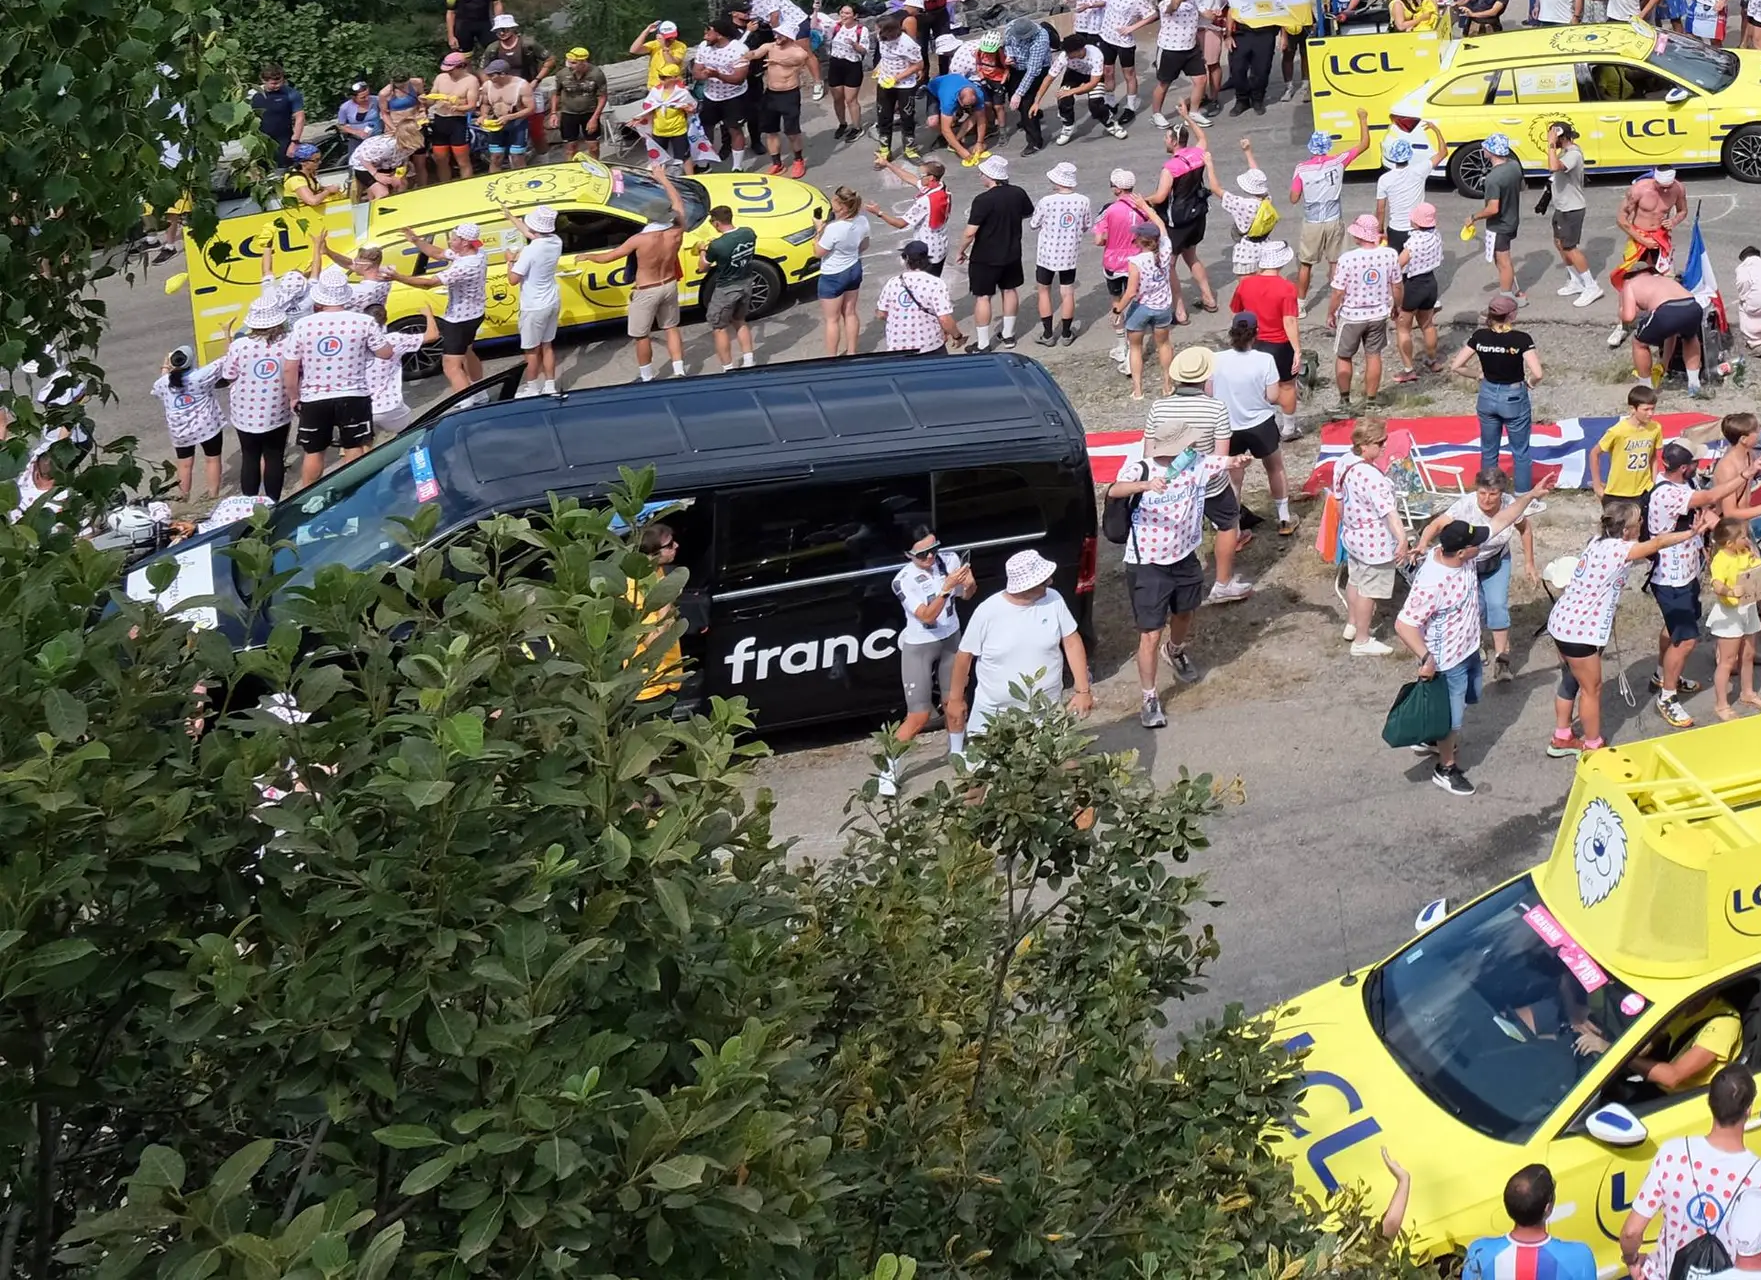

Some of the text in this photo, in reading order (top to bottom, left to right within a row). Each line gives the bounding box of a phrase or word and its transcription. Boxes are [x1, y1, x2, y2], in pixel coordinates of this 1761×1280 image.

[1330, 51, 1404, 76] LCL
[1625, 118, 1688, 139] LCL
[732, 176, 774, 214] LCL
[1626, 452, 1649, 471] 23
[724, 628, 902, 685] franc
